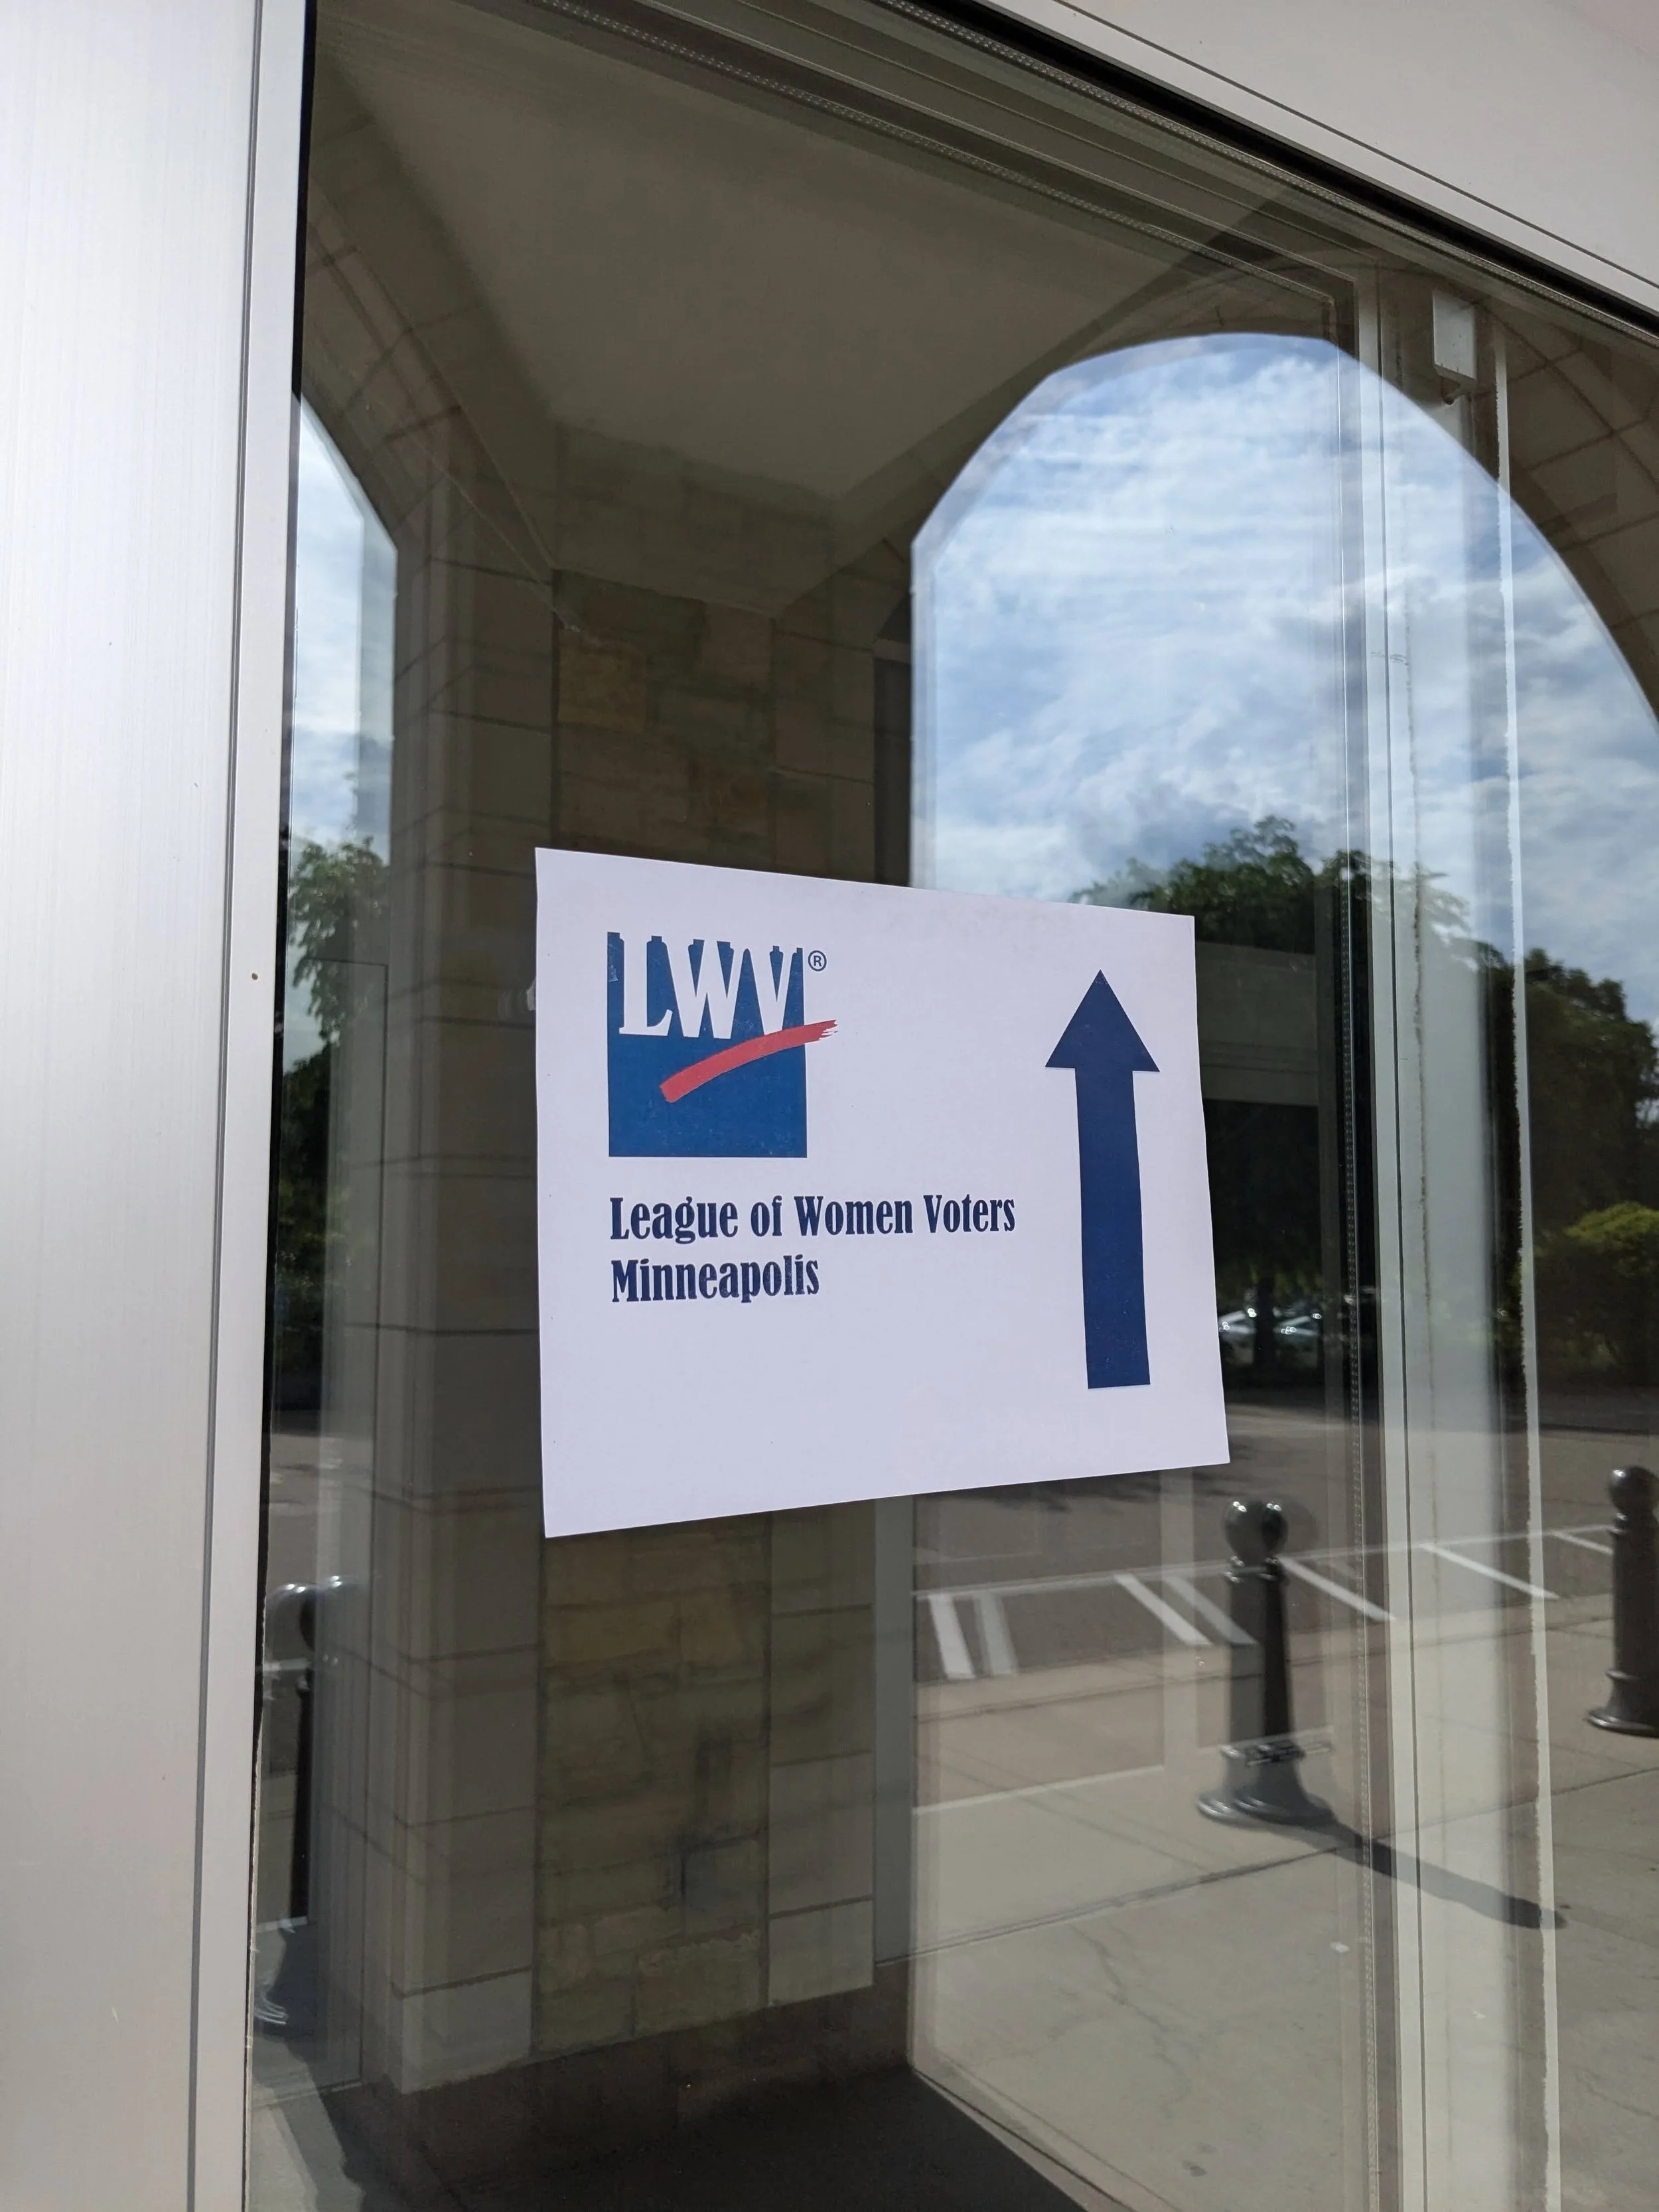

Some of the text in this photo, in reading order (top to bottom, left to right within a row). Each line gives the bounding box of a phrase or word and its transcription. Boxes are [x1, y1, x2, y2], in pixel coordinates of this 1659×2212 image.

[609, 1194, 1016, 1244] League of Women Voters
[611, 1254, 820, 1303] Minneapolis
